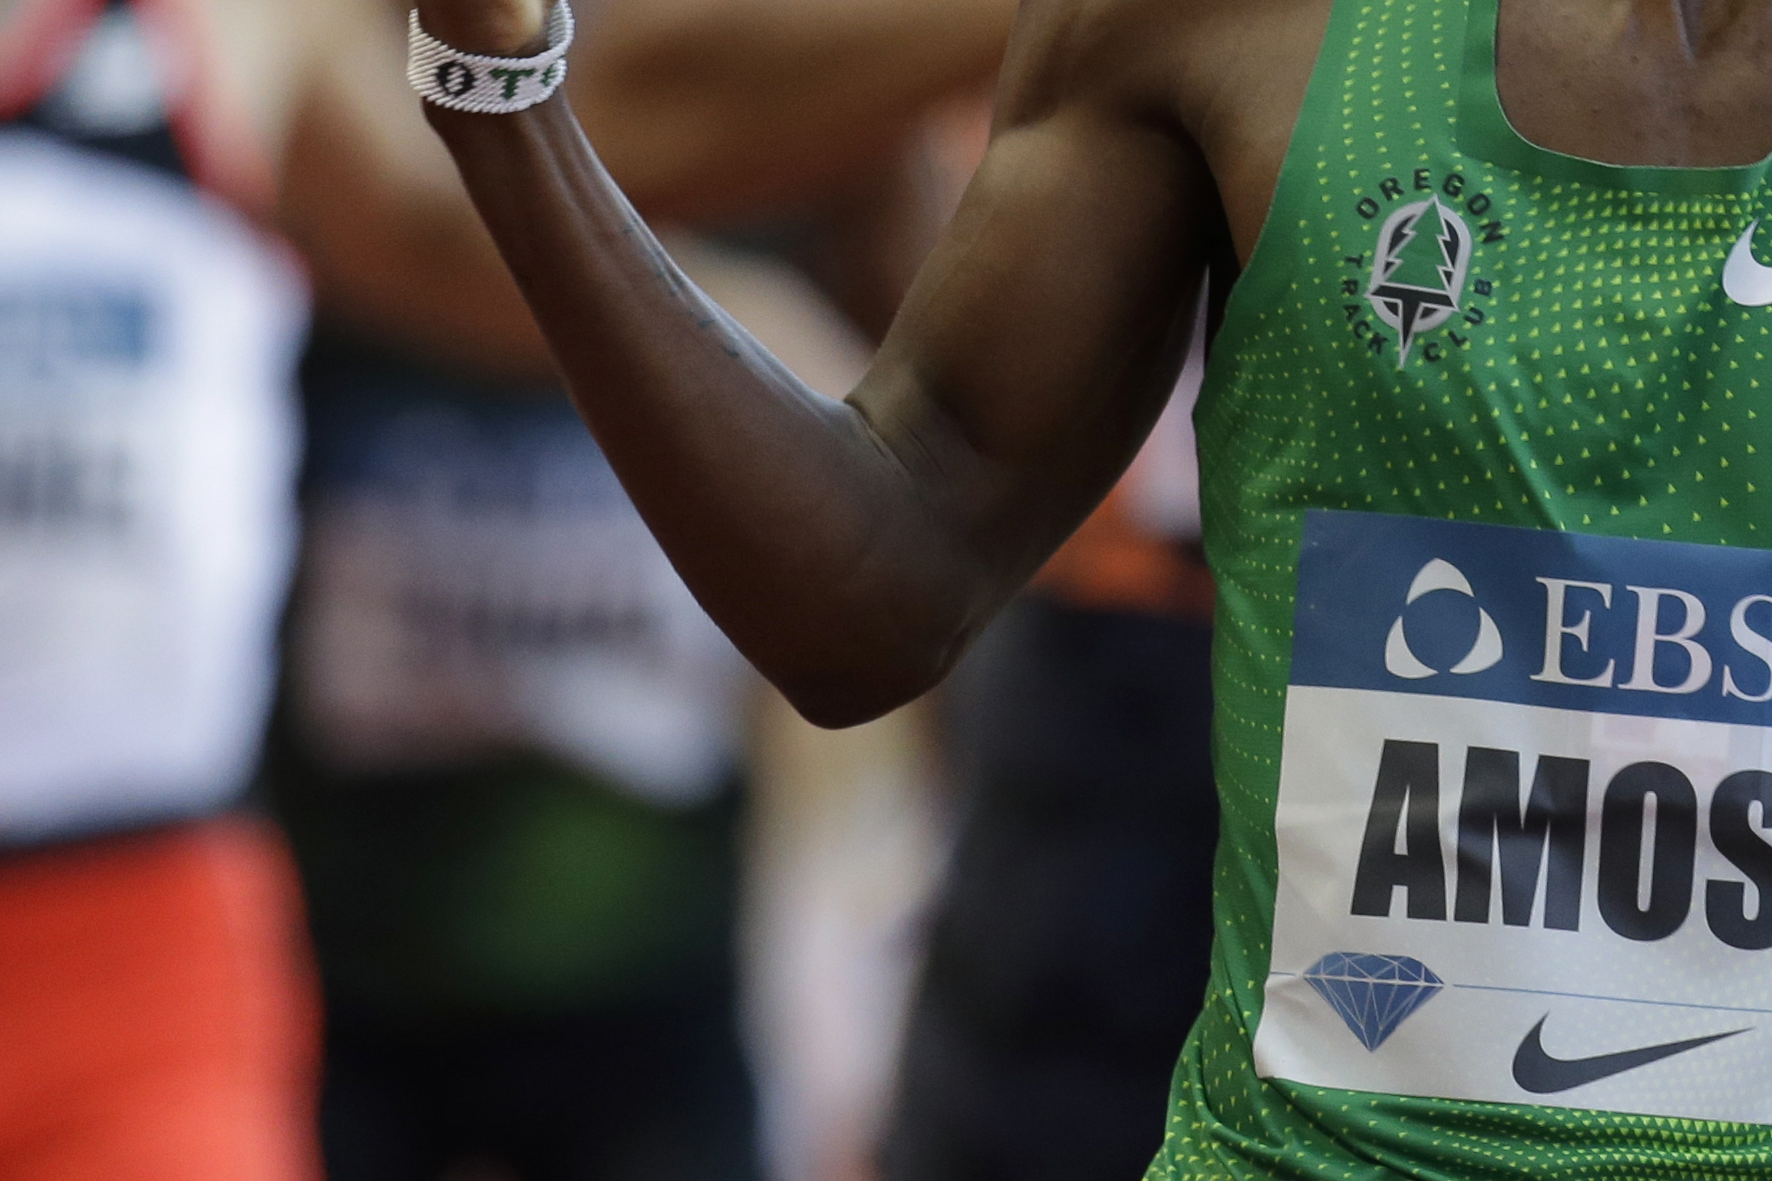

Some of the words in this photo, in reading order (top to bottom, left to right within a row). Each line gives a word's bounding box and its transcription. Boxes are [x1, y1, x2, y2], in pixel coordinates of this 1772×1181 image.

[1356, 168, 1504, 244] OREGON
[1341, 254, 1389, 355] TRACK
[1423, 278, 1493, 363] CLUB
